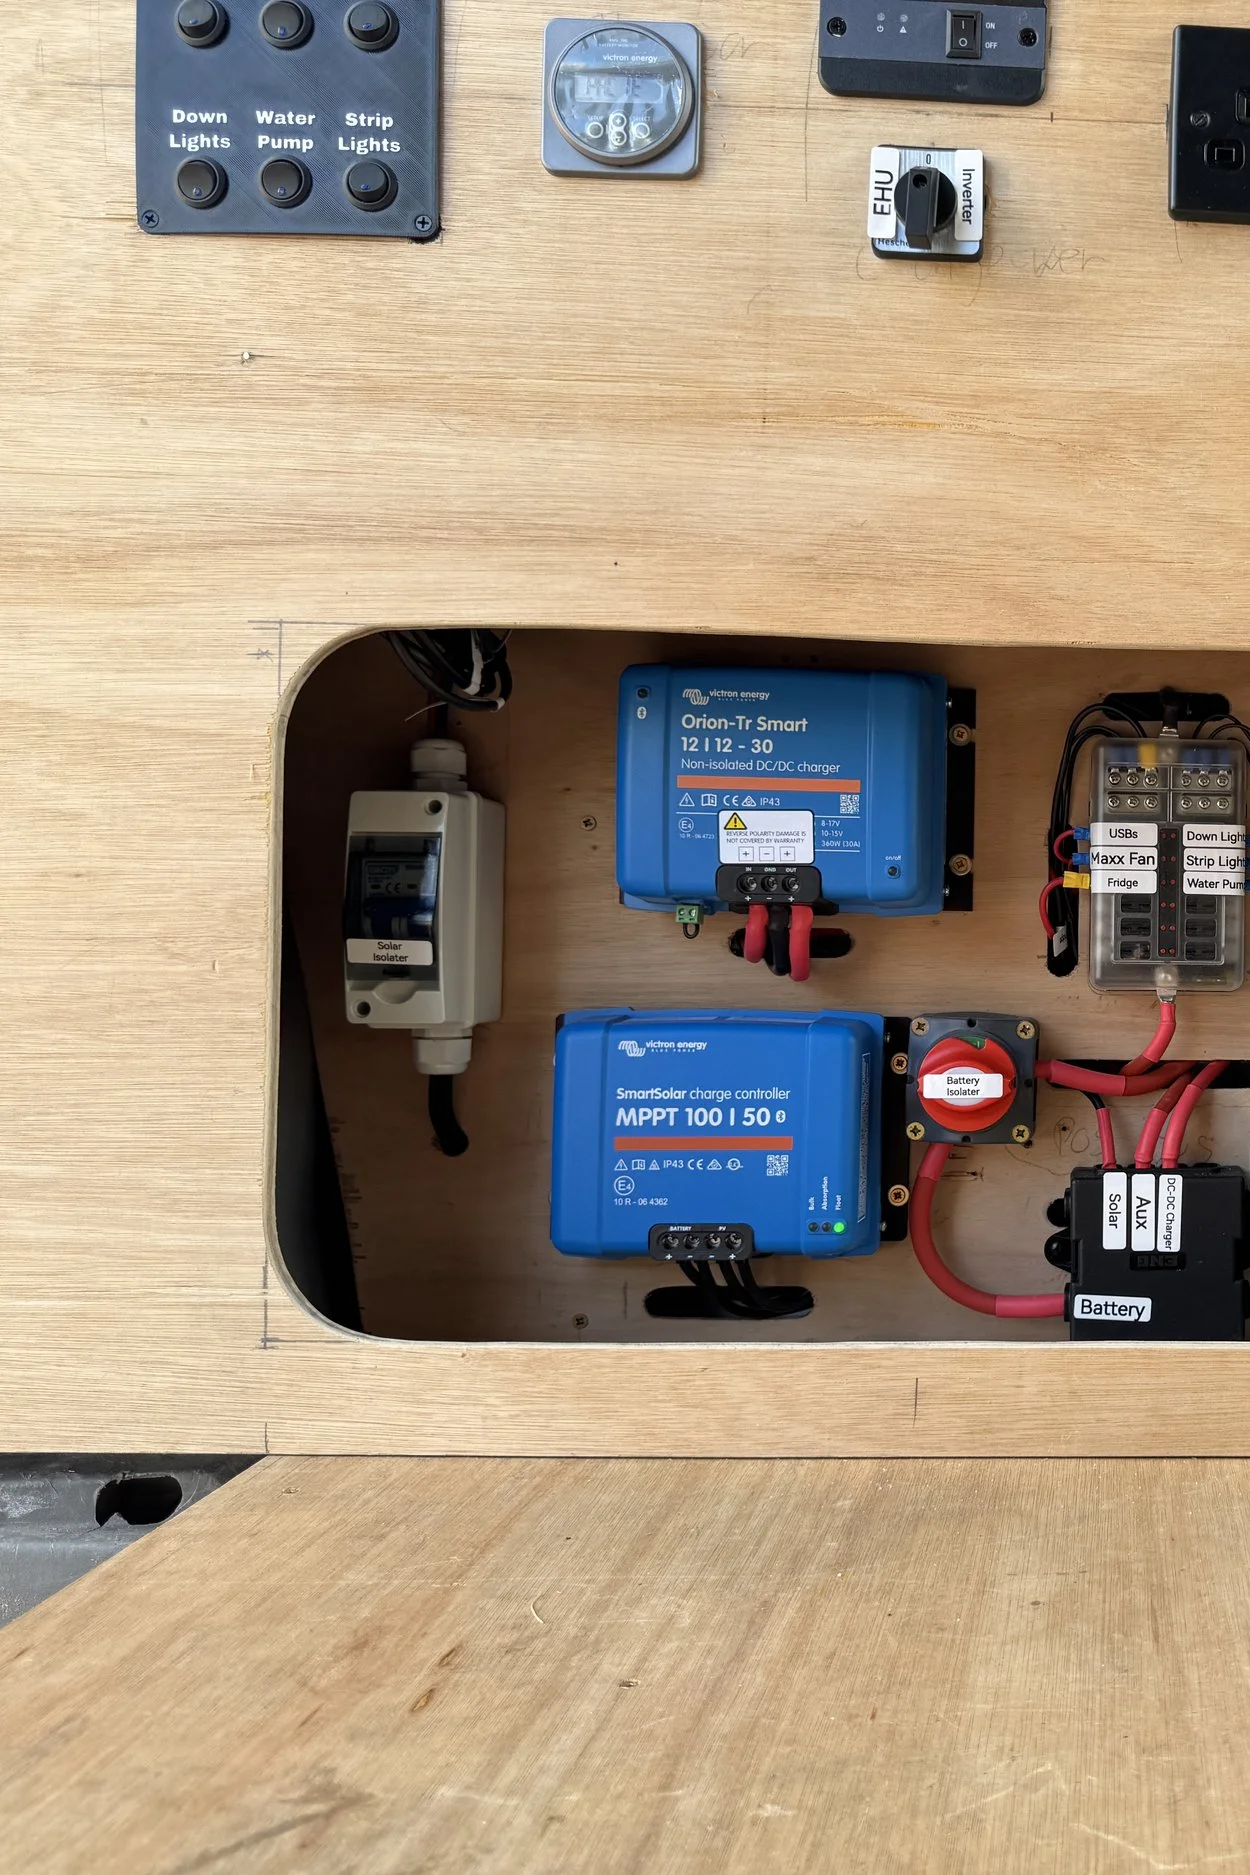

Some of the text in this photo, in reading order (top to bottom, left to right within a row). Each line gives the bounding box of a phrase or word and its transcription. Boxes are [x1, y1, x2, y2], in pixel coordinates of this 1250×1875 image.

[985, 22, 996, 30] ON
[631, 54, 658, 63] energy
[172, 109, 228, 124] Down
[255, 110, 316, 125] Water
[345, 112, 394, 131] Strip
[169, 133, 231, 152] Lights
[257, 135, 314, 153] Pump
[338, 136, 401, 155] Lights
[873, 169, 894, 216] EHU
[962, 168, 976, 225] Inverter
[709, 688, 770, 700] victron energy
[681, 714, 808, 732] Orion-Tr Smart
[681, 736, 699, 752] 12
[715, 737, 732, 753] 12
[751, 738, 774, 754] 30
[681, 758, 841, 776] Non-isolated DC/DC charger
[760, 797, 781, 806] IP43
[820, 820, 840, 828] 8-17V
[821, 830, 844, 838] 10-15V
[1109, 828, 1138, 838] USBs
[1187, 830, 1218, 841] Down
[821, 840, 861, 848] 360W (30A)
[1091, 852, 1155, 866] Maxx Fan
[1186, 854, 1215, 869] Strip
[1108, 878, 1138, 890] Fridge
[1187, 878, 1246, 890] Water Pum
[377, 942, 402, 950] Solar
[373, 952, 409, 962] Isolater
[646, 1040, 708, 1050] victron energy
[946, 1076, 980, 1086] Battery
[616, 1087, 790, 1102] SmartSolar charge controller
[946, 1088, 980, 1096] Isolater
[616, 1107, 680, 1126] MPPT
[685, 1107, 723, 1126] 100
[742, 1107, 771, 1126] 50
[663, 1160, 684, 1168] IP43
[822, 1176, 830, 1210] Absorption
[614, 1198, 624, 1206] 10
[625, 1198, 632, 1206] R
[638, 1198, 648, 1206] 06
[649, 1198, 668, 1206] 4362
[1108, 1194, 1122, 1229] Solar
[1136, 1196, 1152, 1230] Aux
[1163, 1178, 1176, 1250] DC-DC Charger
[1080, 1299, 1146, 1323] Battery
